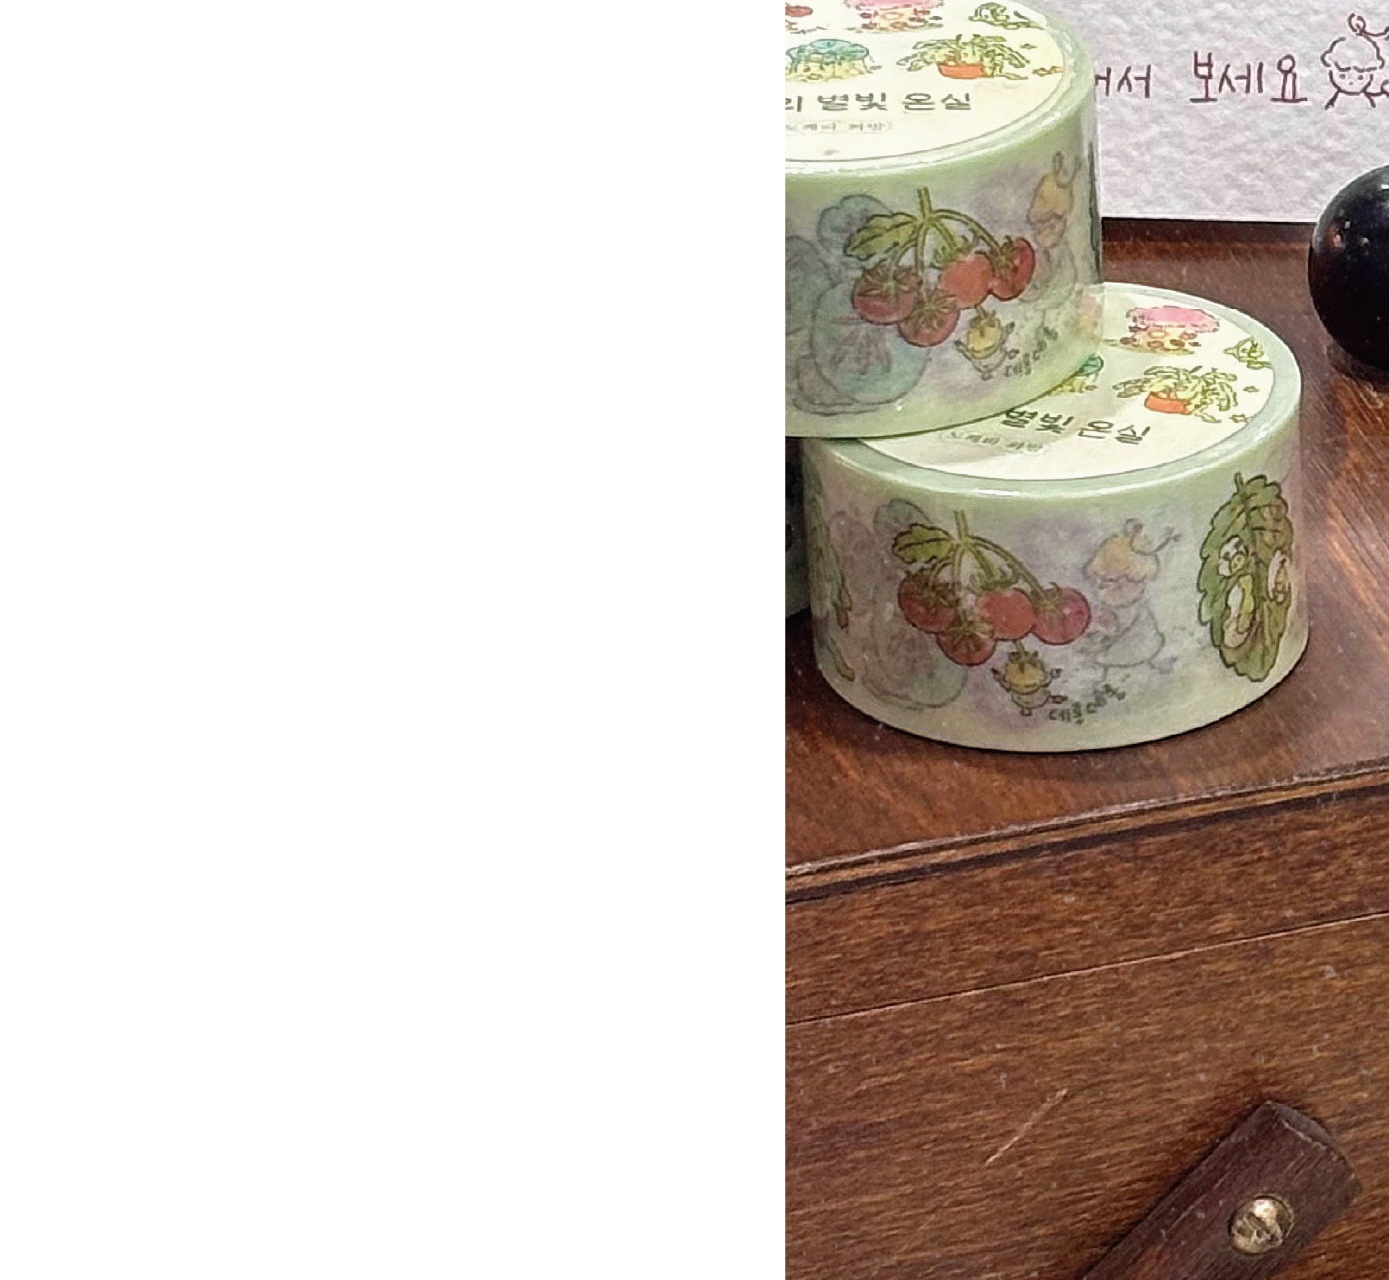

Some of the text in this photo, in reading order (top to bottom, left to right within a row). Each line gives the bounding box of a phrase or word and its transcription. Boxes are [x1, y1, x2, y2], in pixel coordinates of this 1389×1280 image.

[1189, 50, 1308, 103] 보세요
[816, 91, 888, 112] 별빛
[901, 92, 972, 112] 온실
[1001, 410, 1151, 445] 별빛 온실
